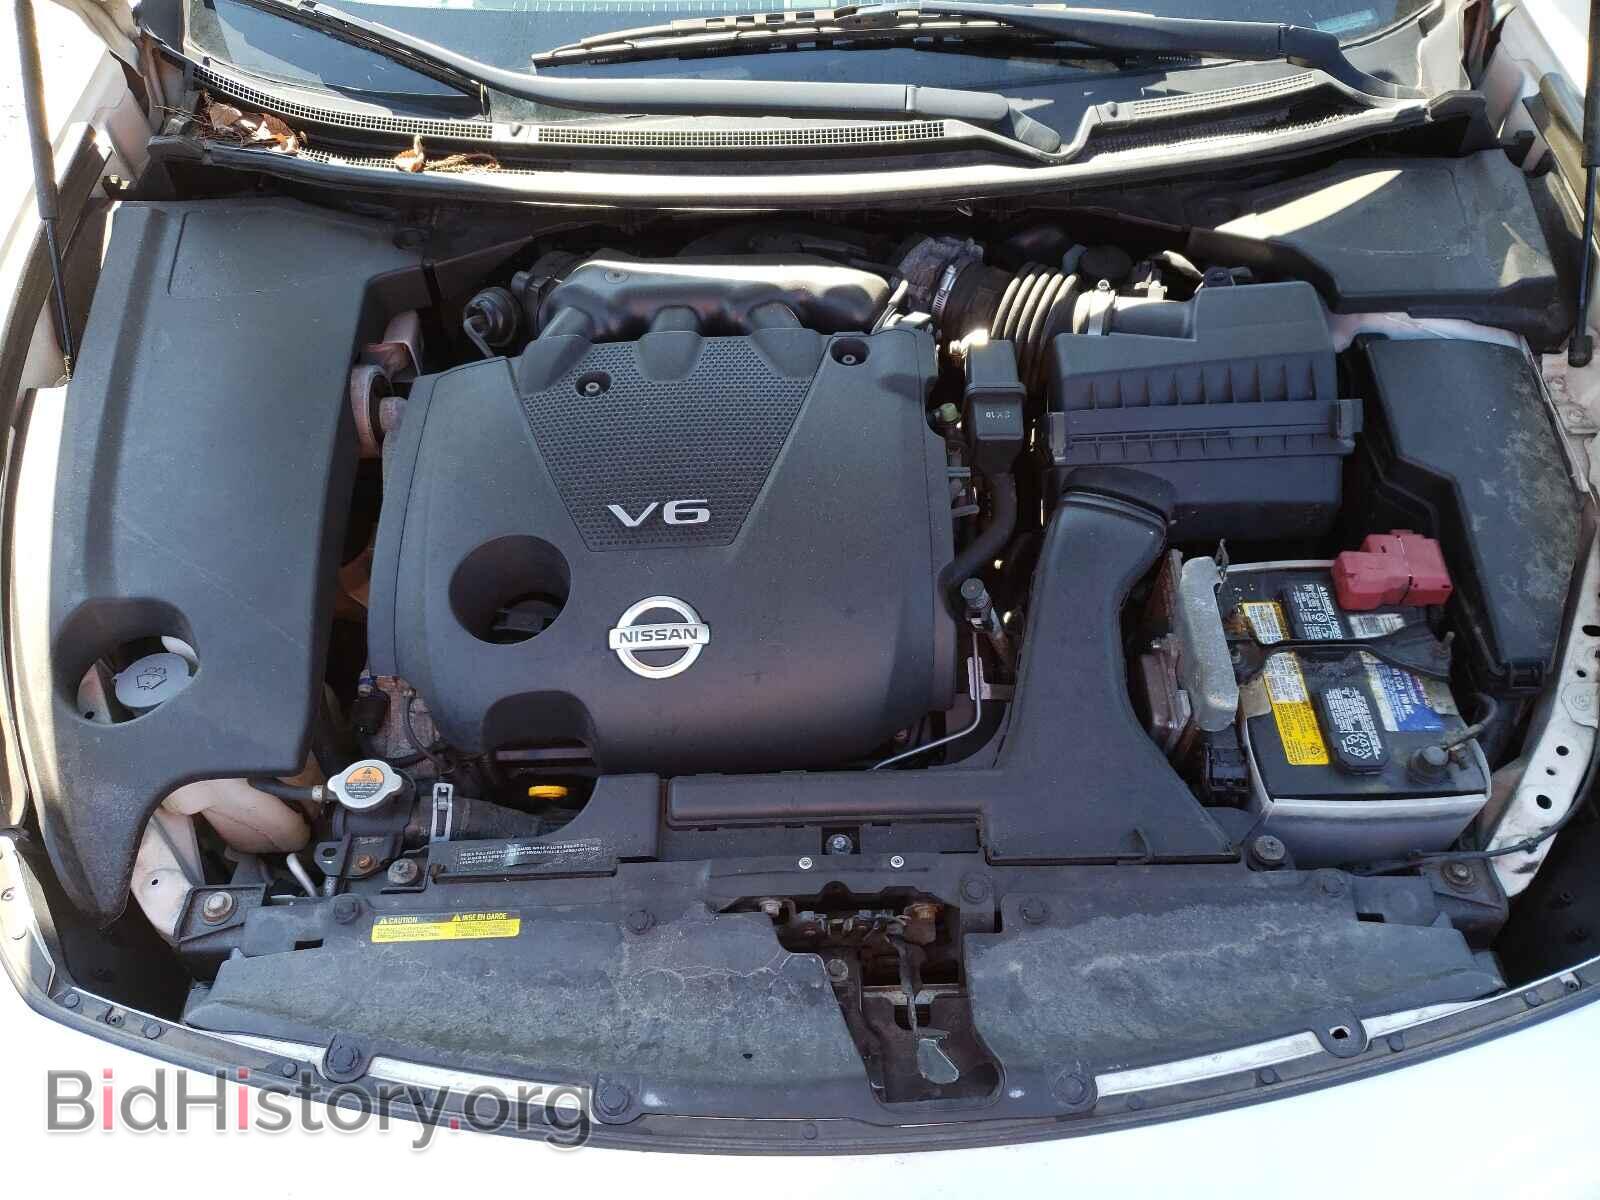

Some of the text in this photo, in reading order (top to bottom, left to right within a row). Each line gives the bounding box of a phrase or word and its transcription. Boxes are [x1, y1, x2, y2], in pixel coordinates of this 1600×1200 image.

[608, 499, 710, 527] V6
[619, 628, 698, 643] NISSAN
[487, 911, 507, 920] GARDE
